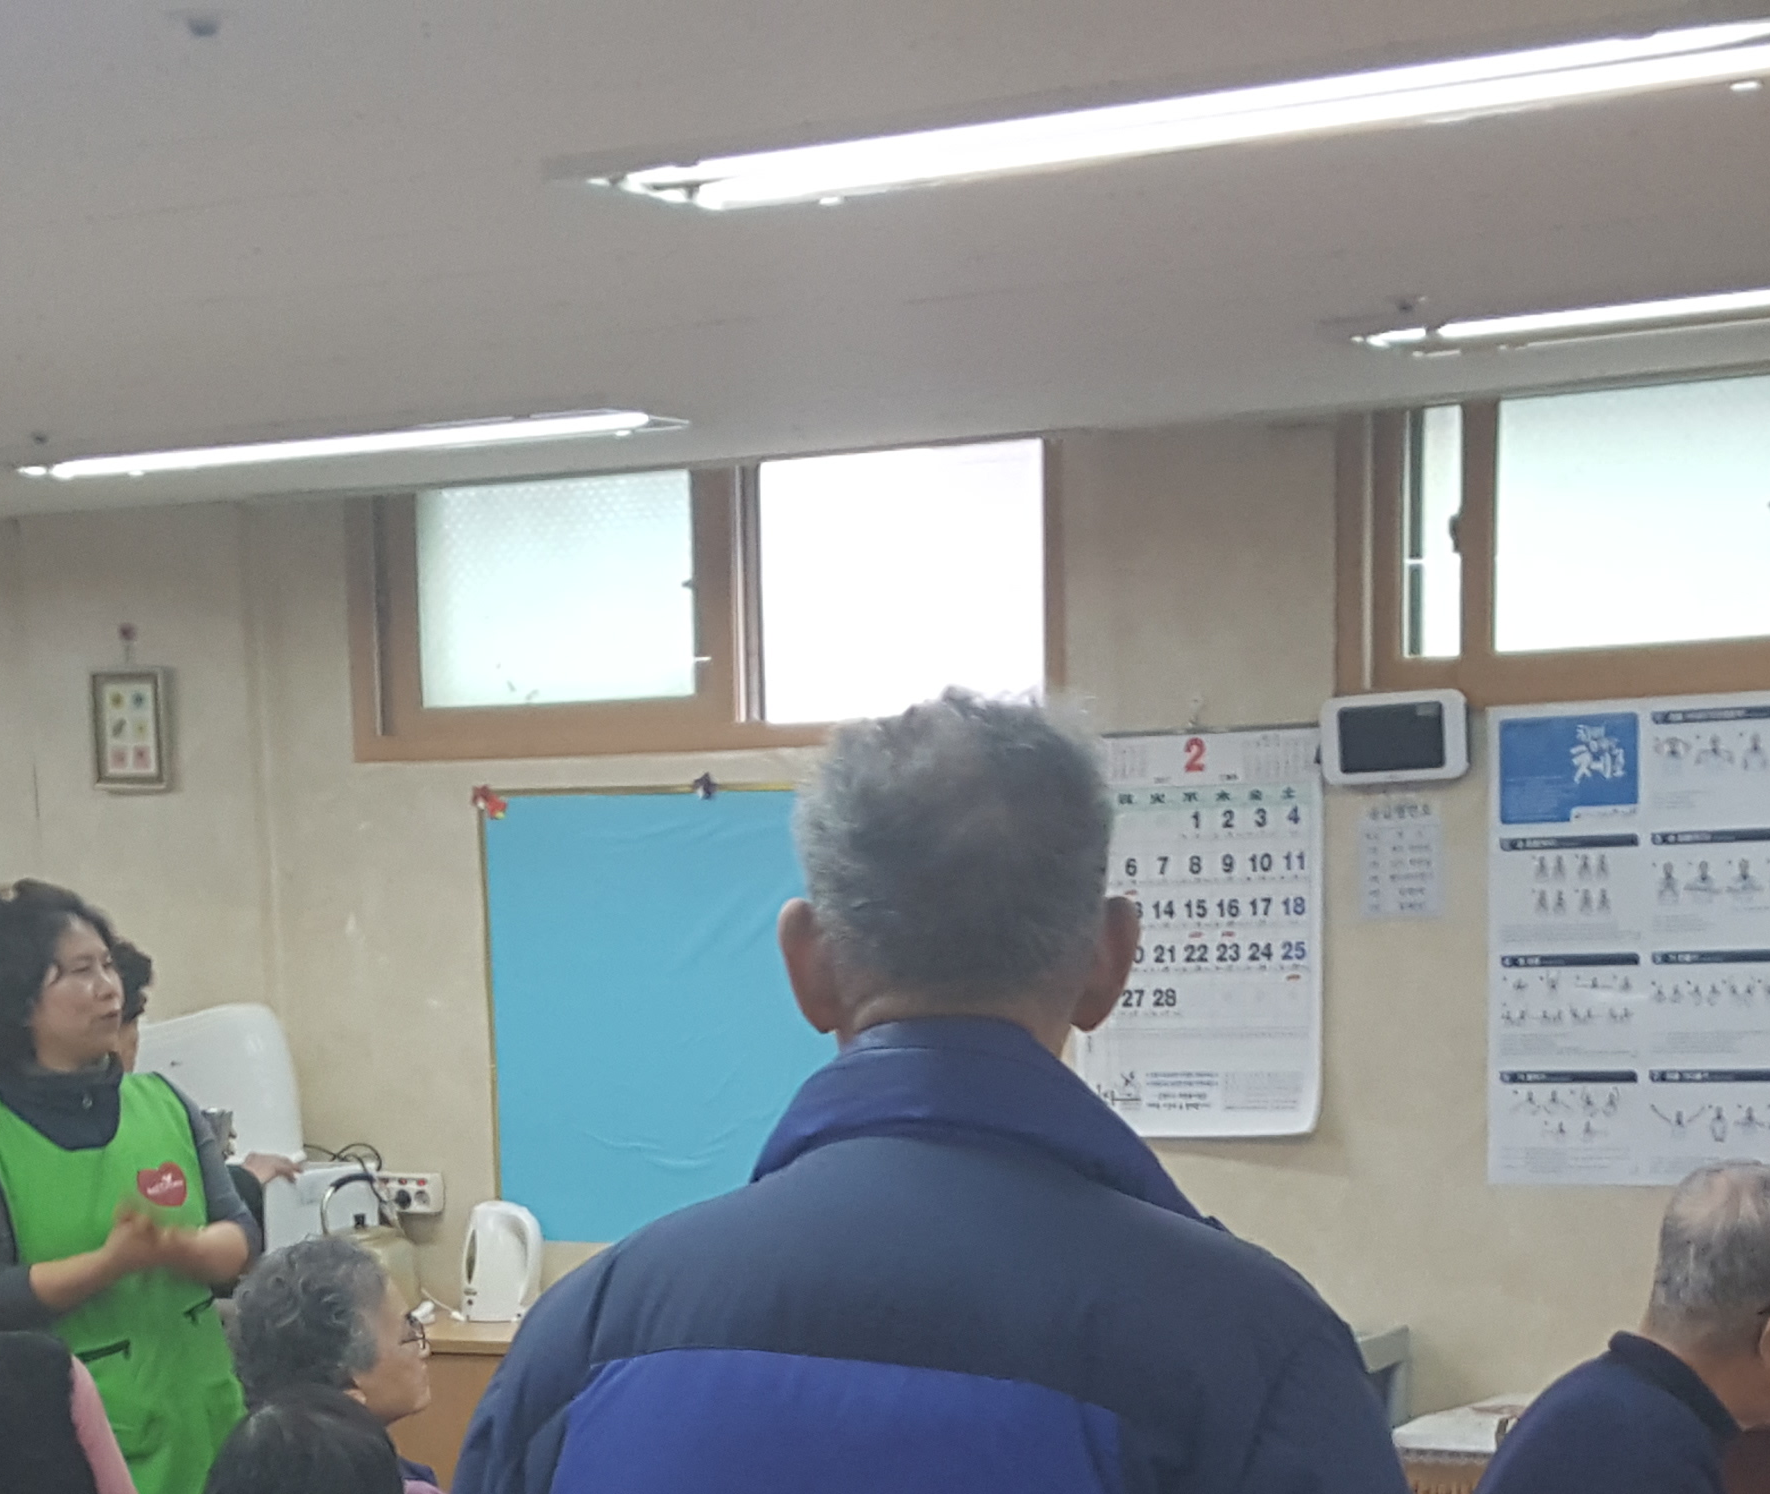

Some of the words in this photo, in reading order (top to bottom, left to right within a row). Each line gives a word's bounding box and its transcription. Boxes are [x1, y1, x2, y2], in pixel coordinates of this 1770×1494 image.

[1184, 737, 1206, 773] 2
[1191, 811, 1201, 828] 1
[1222, 809, 1235, 828] 2
[1255, 808, 1267, 827] 3
[1287, 805, 1301, 825] 4
[1125, 858, 1137, 877] 6
[1157, 856, 1169, 875] 7
[1189, 856, 1202, 875] 8
[1222, 854, 1234, 873] 9
[1248, 853, 1273, 873] 10
[1283, 851, 1306, 871] 11
[1152, 900, 1175, 919] 14
[1185, 899, 1207, 919] 15
[1217, 898, 1240, 918] 16
[1250, 898, 1272, 917] 17
[1282, 897, 1306, 916] 18
[1153, 945, 1176, 963] 21
[1184, 944, 1208, 963] 22
[1216, 943, 1240, 962] 23
[1248, 942, 1273, 962] 24
[1281, 941, 1307, 960] 25
[1121, 989, 1145, 1007] 27
[1153, 988, 1177, 1008] 28
